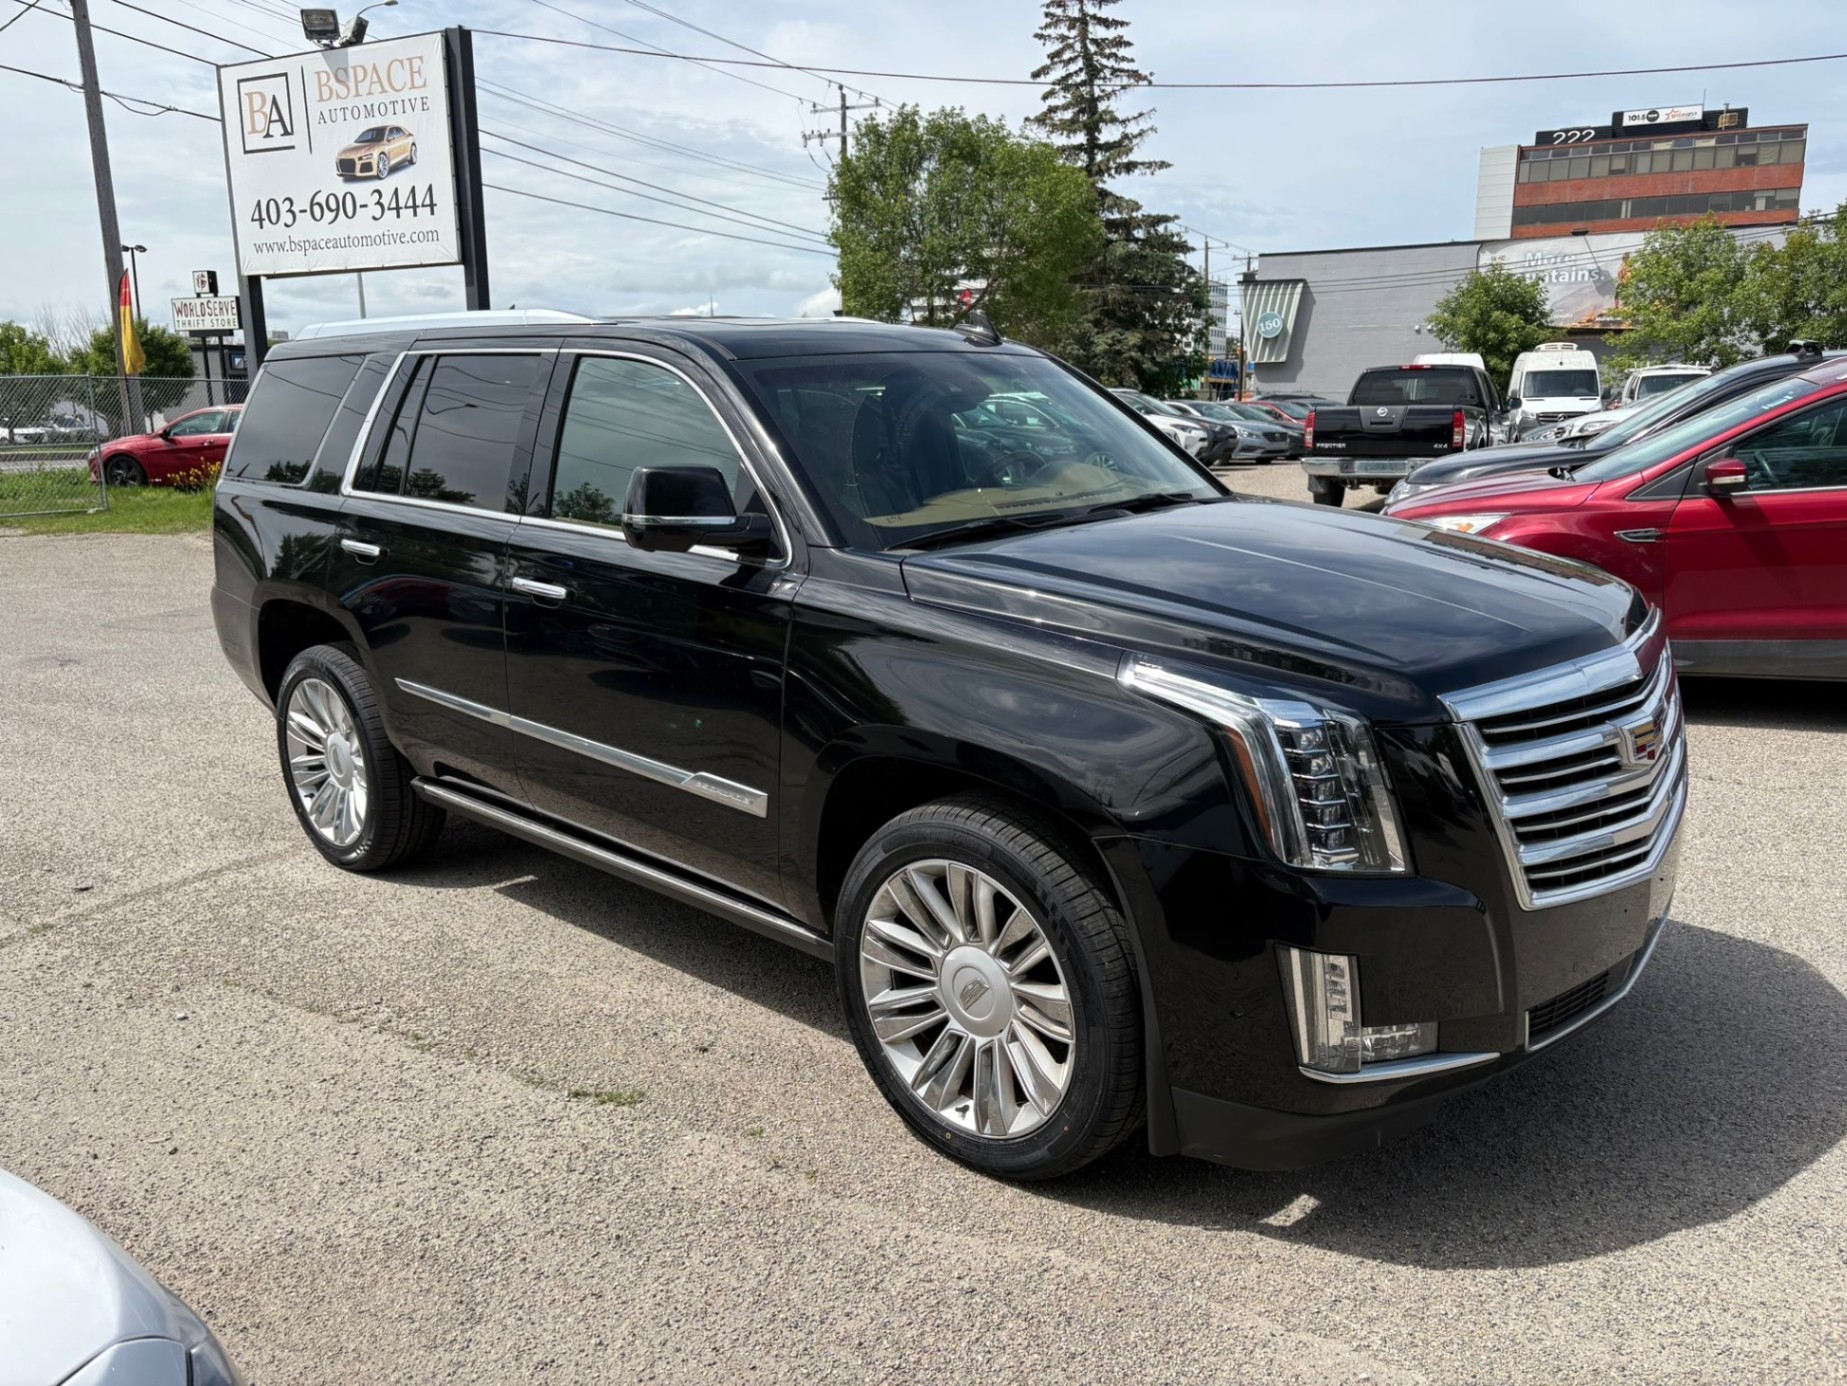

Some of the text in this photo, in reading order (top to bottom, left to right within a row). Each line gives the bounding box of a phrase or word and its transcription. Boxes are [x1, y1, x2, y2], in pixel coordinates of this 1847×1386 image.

[314, 56, 428, 103] BSPACE
[244, 90, 293, 139] BA
[317, 96, 430, 125] AUTOMOTIVE
[1553, 129, 1596, 145] 222
[250, 183, 437, 230] 403-690-3444
[253, 229, 440, 256] www.bspaceautomotive.com
[176, 318, 237, 328] THRIFT STORE
[1260, 318, 1281, 332] 150
